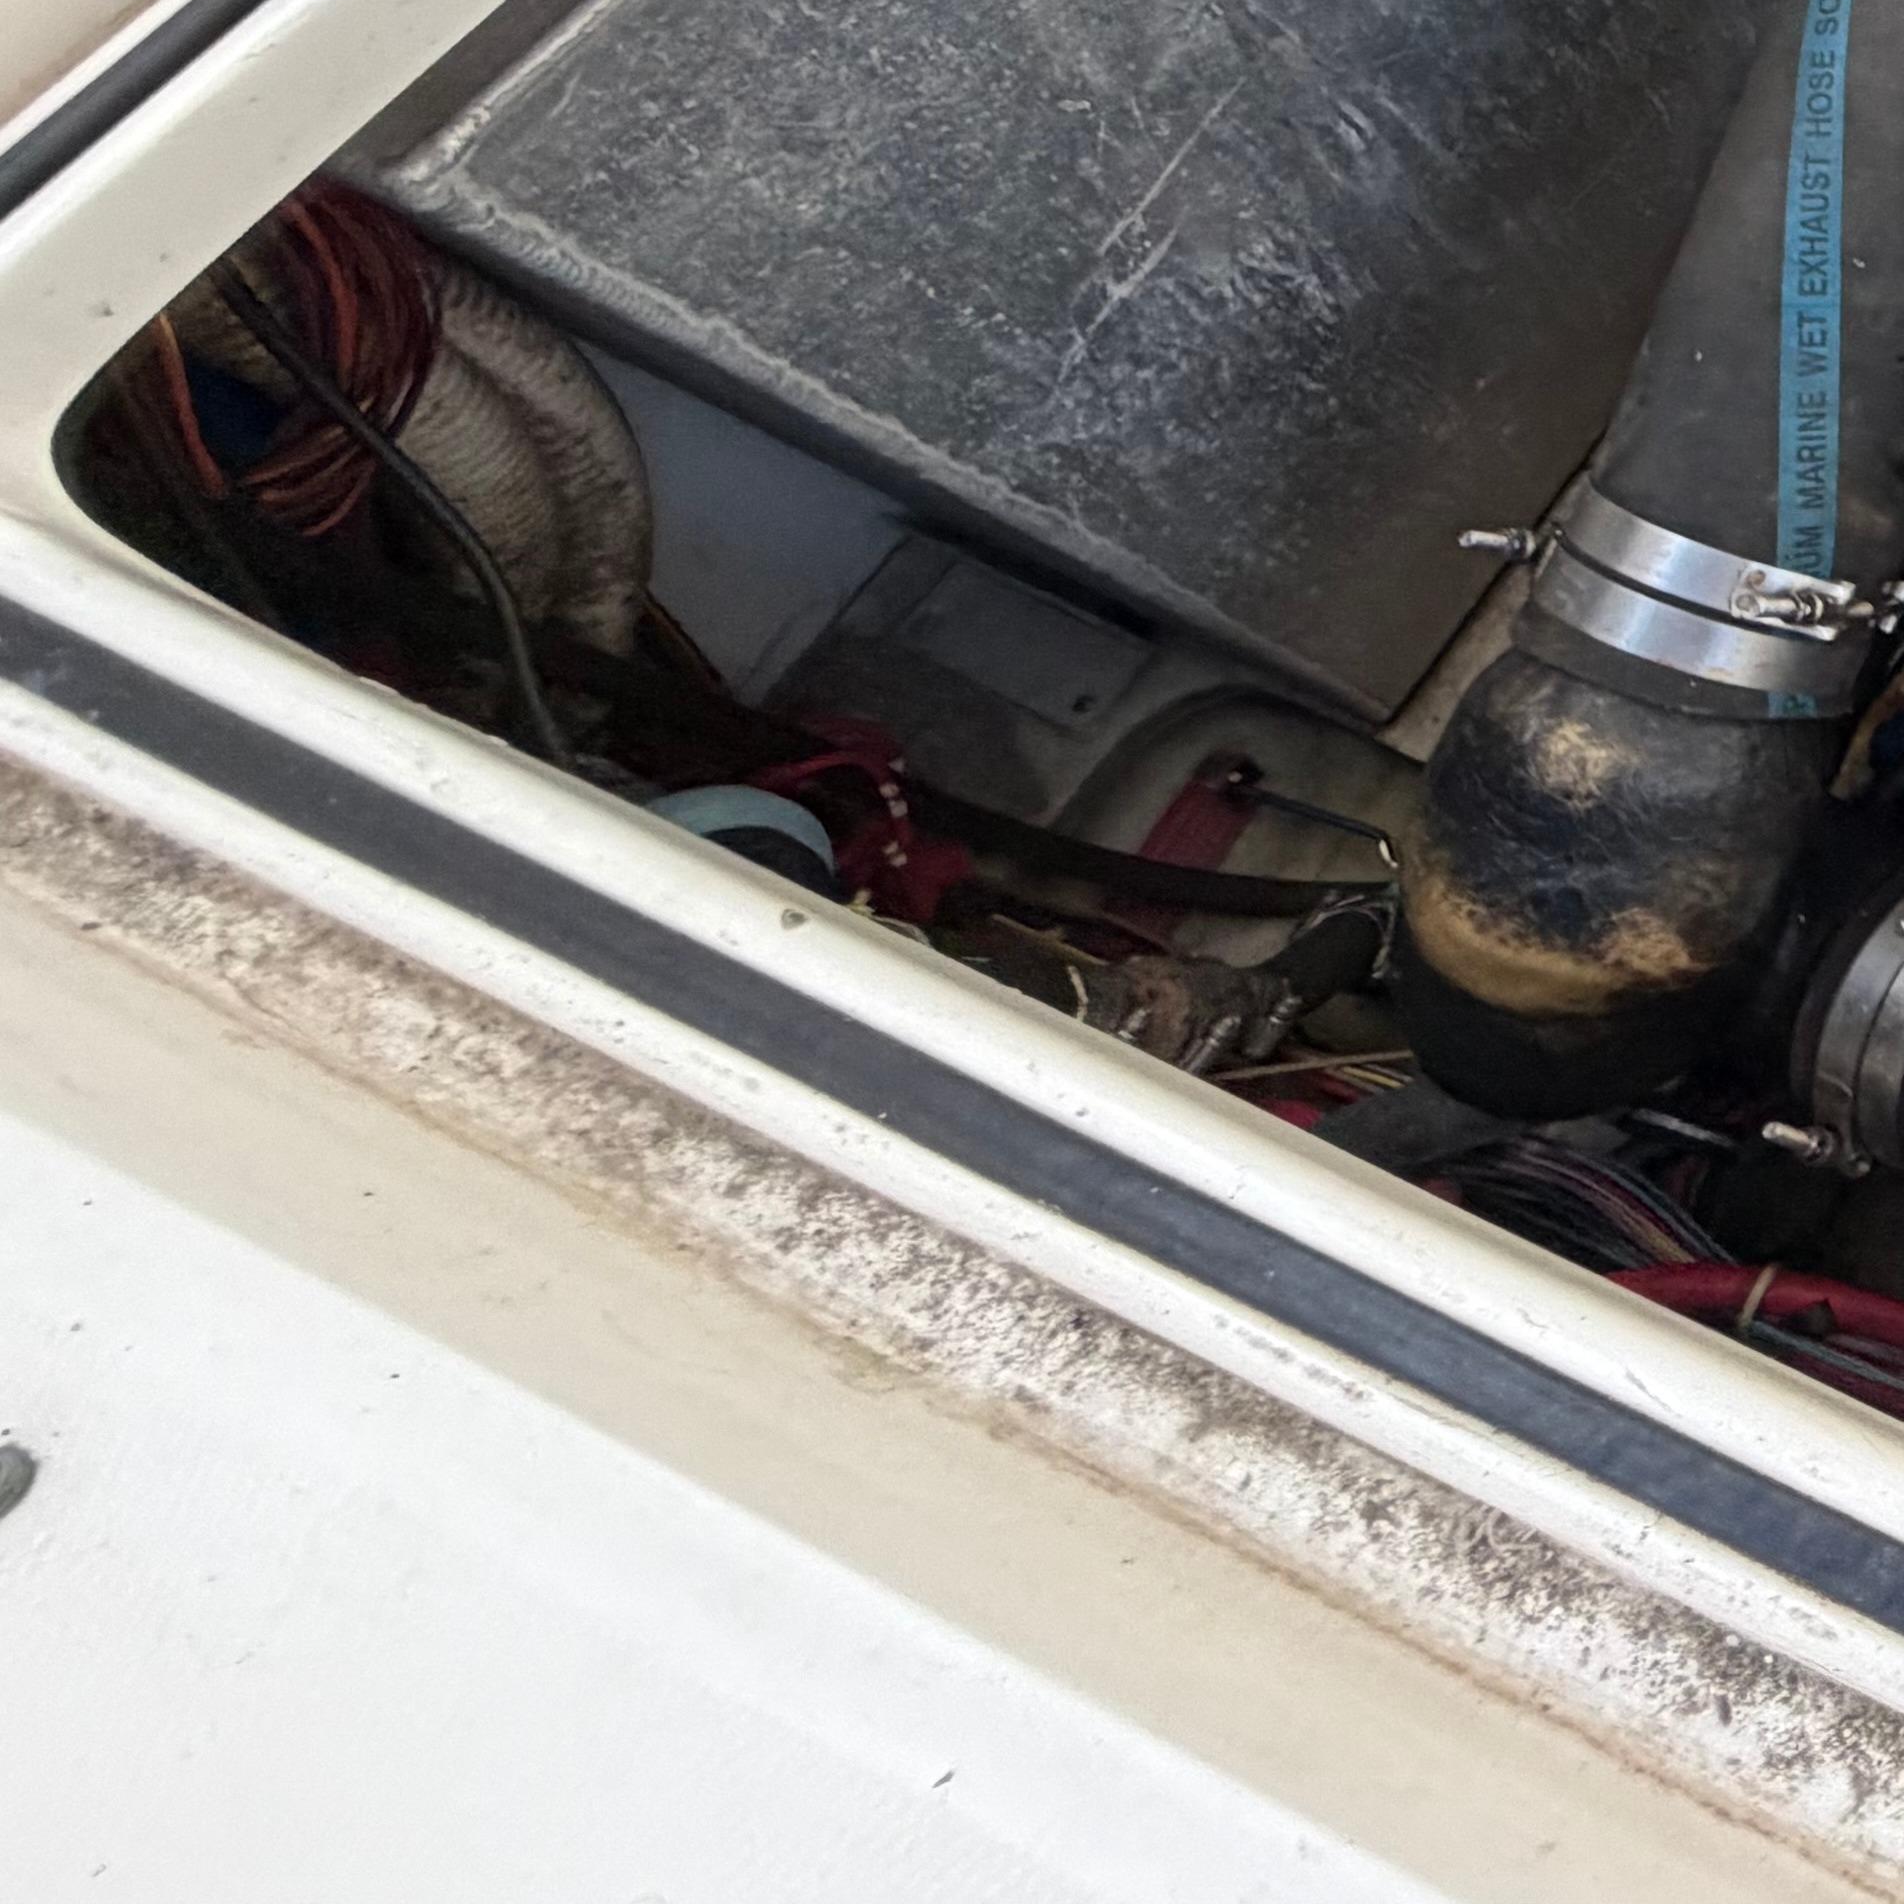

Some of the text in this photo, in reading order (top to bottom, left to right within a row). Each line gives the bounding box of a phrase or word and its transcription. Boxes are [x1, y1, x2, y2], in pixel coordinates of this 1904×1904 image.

[1806, 50, 1837, 138] HOSE
[1797, 154, 1831, 298] EXHAUST
[1797, 312, 1829, 380] WET
[1795, 392, 1828, 512] MARINE
